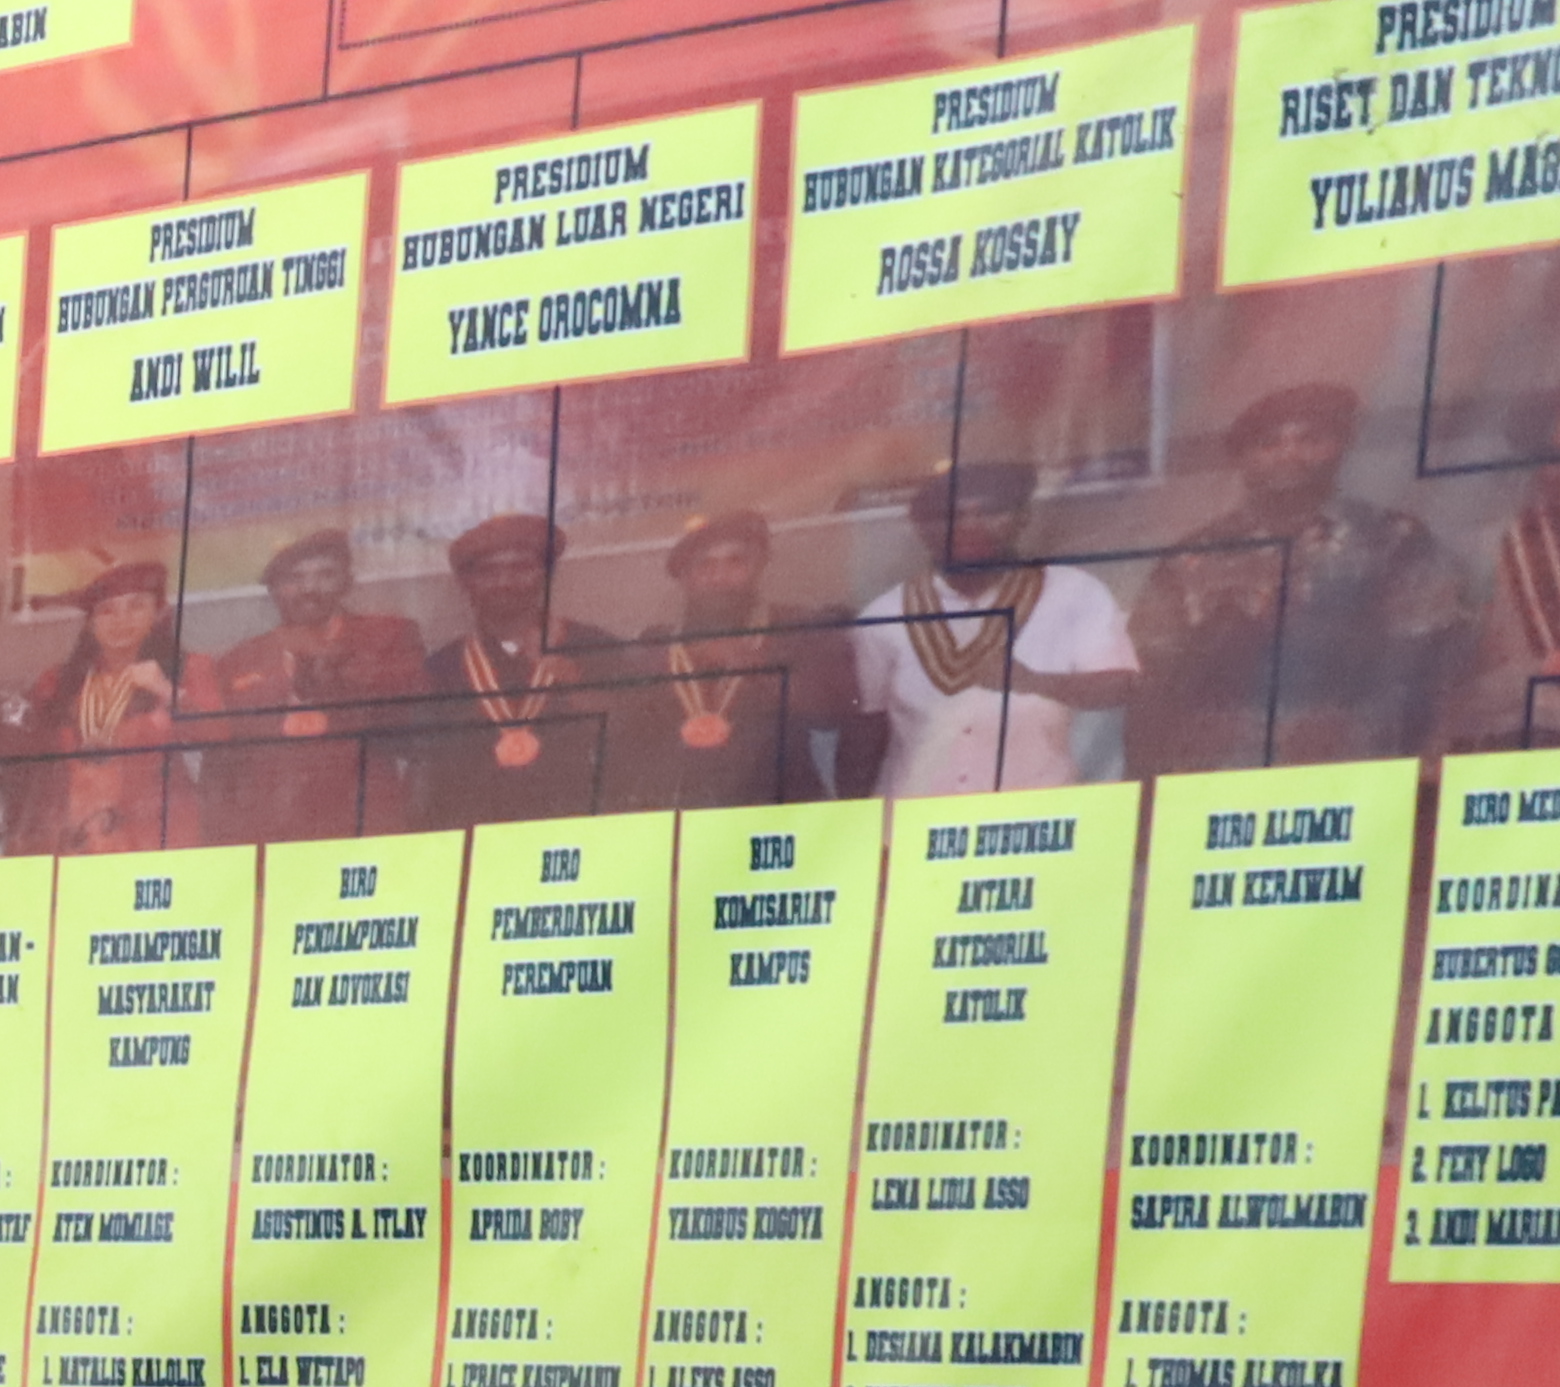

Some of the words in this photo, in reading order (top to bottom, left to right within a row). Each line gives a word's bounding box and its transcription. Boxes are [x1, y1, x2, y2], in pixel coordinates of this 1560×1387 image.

[1376, 0, 1556, 54] PRESIDIUM
[933, 72, 1059, 134] PRESIDIUM
[1280, 77, 1377, 137] RISET
[1388, 66, 1454, 122] DAN
[495, 144, 649, 204] PRESIDIUM
[803, 156, 924, 213] HUBUNGAN
[932, 129, 1064, 193] KATEGORIAL
[1073, 107, 1176, 164] KATOLIK
[1311, 155, 1475, 229] YULIANUS
[150, 208, 255, 262] PRESIDIUM
[403, 214, 545, 271] HUBUNGAN
[556, 201, 627, 246] LUAR
[639, 182, 745, 233] NEGERI
[877, 235, 962, 295] ROSSA
[970, 212, 1080, 277] KOSSAY
[58, 281, 155, 333] HUBUNGAN
[161, 261, 274, 316] PERGURUAN
[283, 249, 346, 296] TINGGI
[449, 299, 529, 354] YANCE
[538, 277, 681, 342] OROCOMNA
[130, 353, 183, 402] ANDI
[193, 342, 260, 392] WILIL
[540, 849, 580, 883] BIRO
[750, 835, 795, 871] BIRO
[134, 878, 172, 910] BIRO
[340, 866, 377, 899] BIRO
[1192, 873, 1235, 909] DAN
[491, 901, 635, 940] PEMBERDAYAAN
[714, 890, 836, 930] KOMISARIAT
[89, 929, 221, 964] PENDAMPINGAN
[293, 917, 418, 954] PENDAMPINGAN
[502, 959, 613, 996] PEREMPUAN
[730, 950, 810, 986] KAMPUS
[98, 981, 215, 1015] MASYARAKAT
[292, 977, 324, 1007] DAN
[328, 972, 410, 1005] ADVOKASI
[944, 988, 1027, 1023] KATOLIK
[109, 1035, 190, 1067] KAMPUNG
[252, 1209, 345, 1240] AGUSTINUS
[373, 1207, 427, 1239] ITLAY
[132, 1358, 206, 1387] KALOLIK
